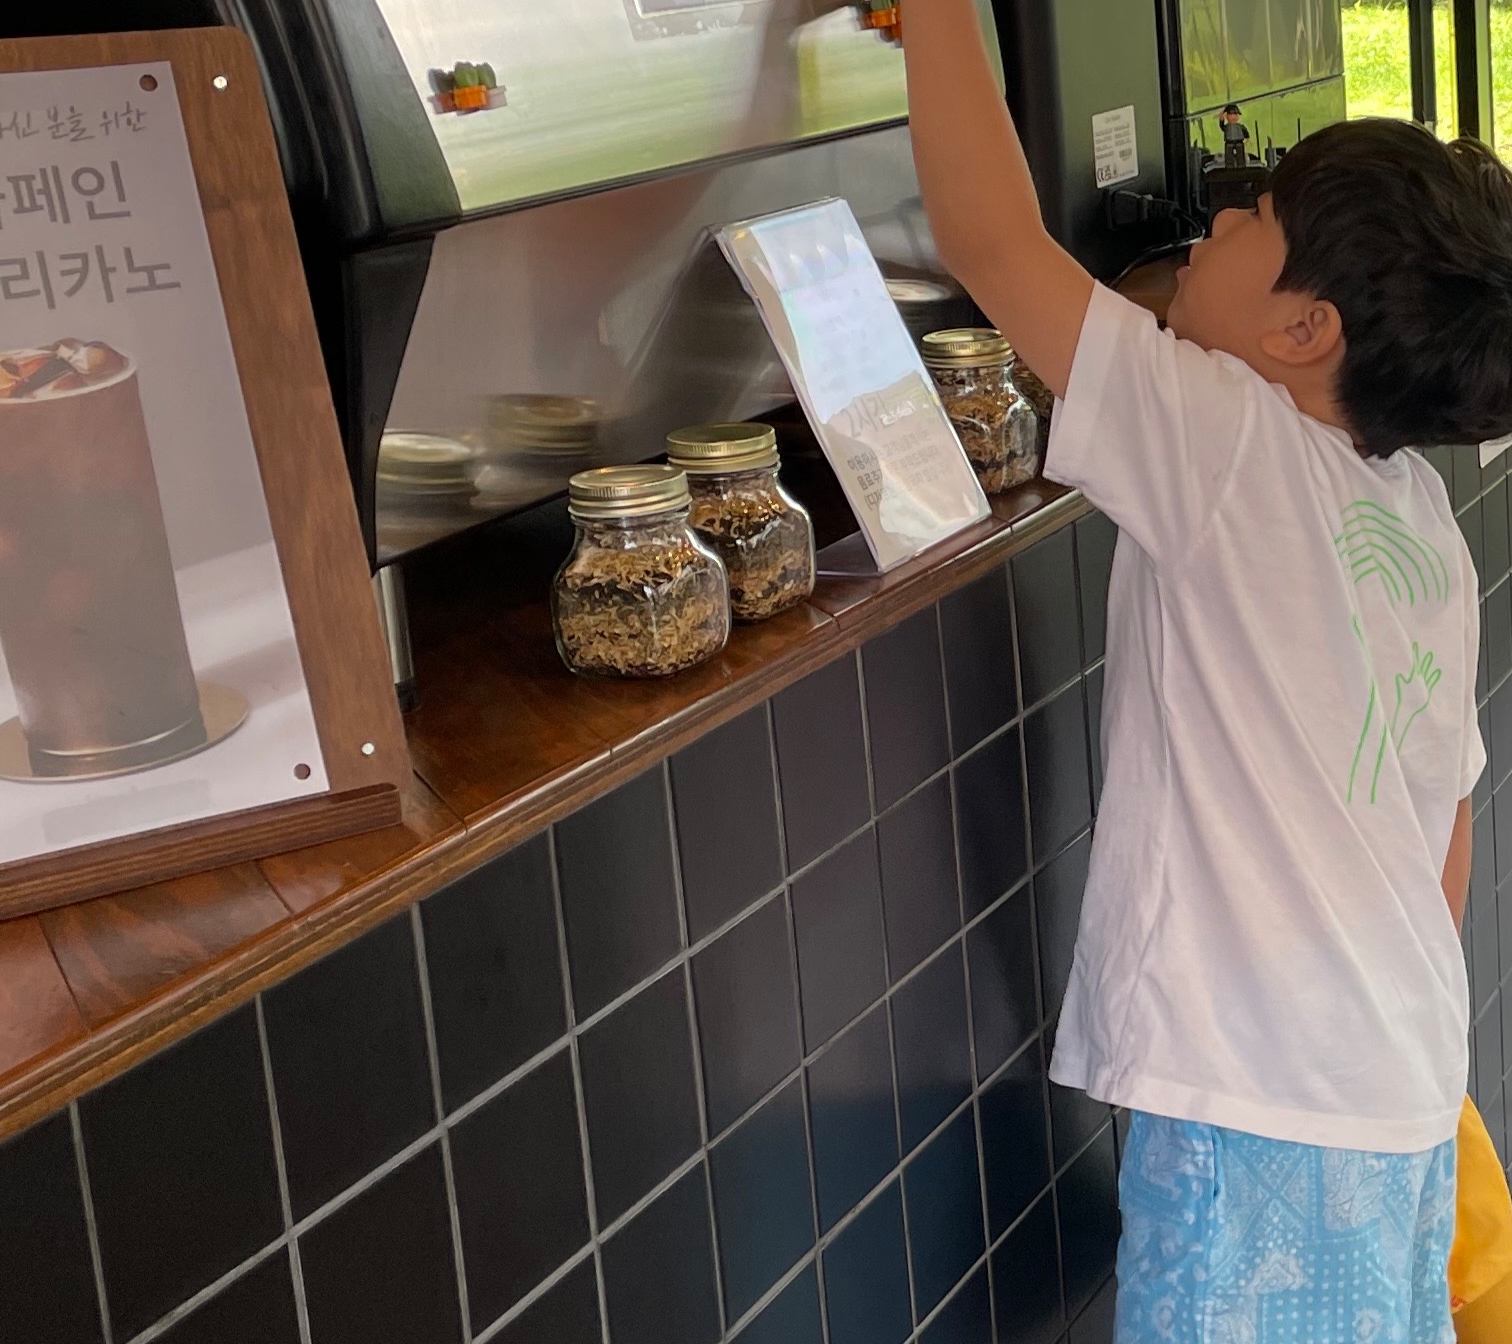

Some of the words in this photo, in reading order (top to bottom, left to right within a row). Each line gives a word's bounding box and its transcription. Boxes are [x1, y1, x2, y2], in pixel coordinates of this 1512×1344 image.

[47, 105, 96, 142] 분을
[100, 101, 147, 136] 위한
[0, 160, 131, 229] 페인
